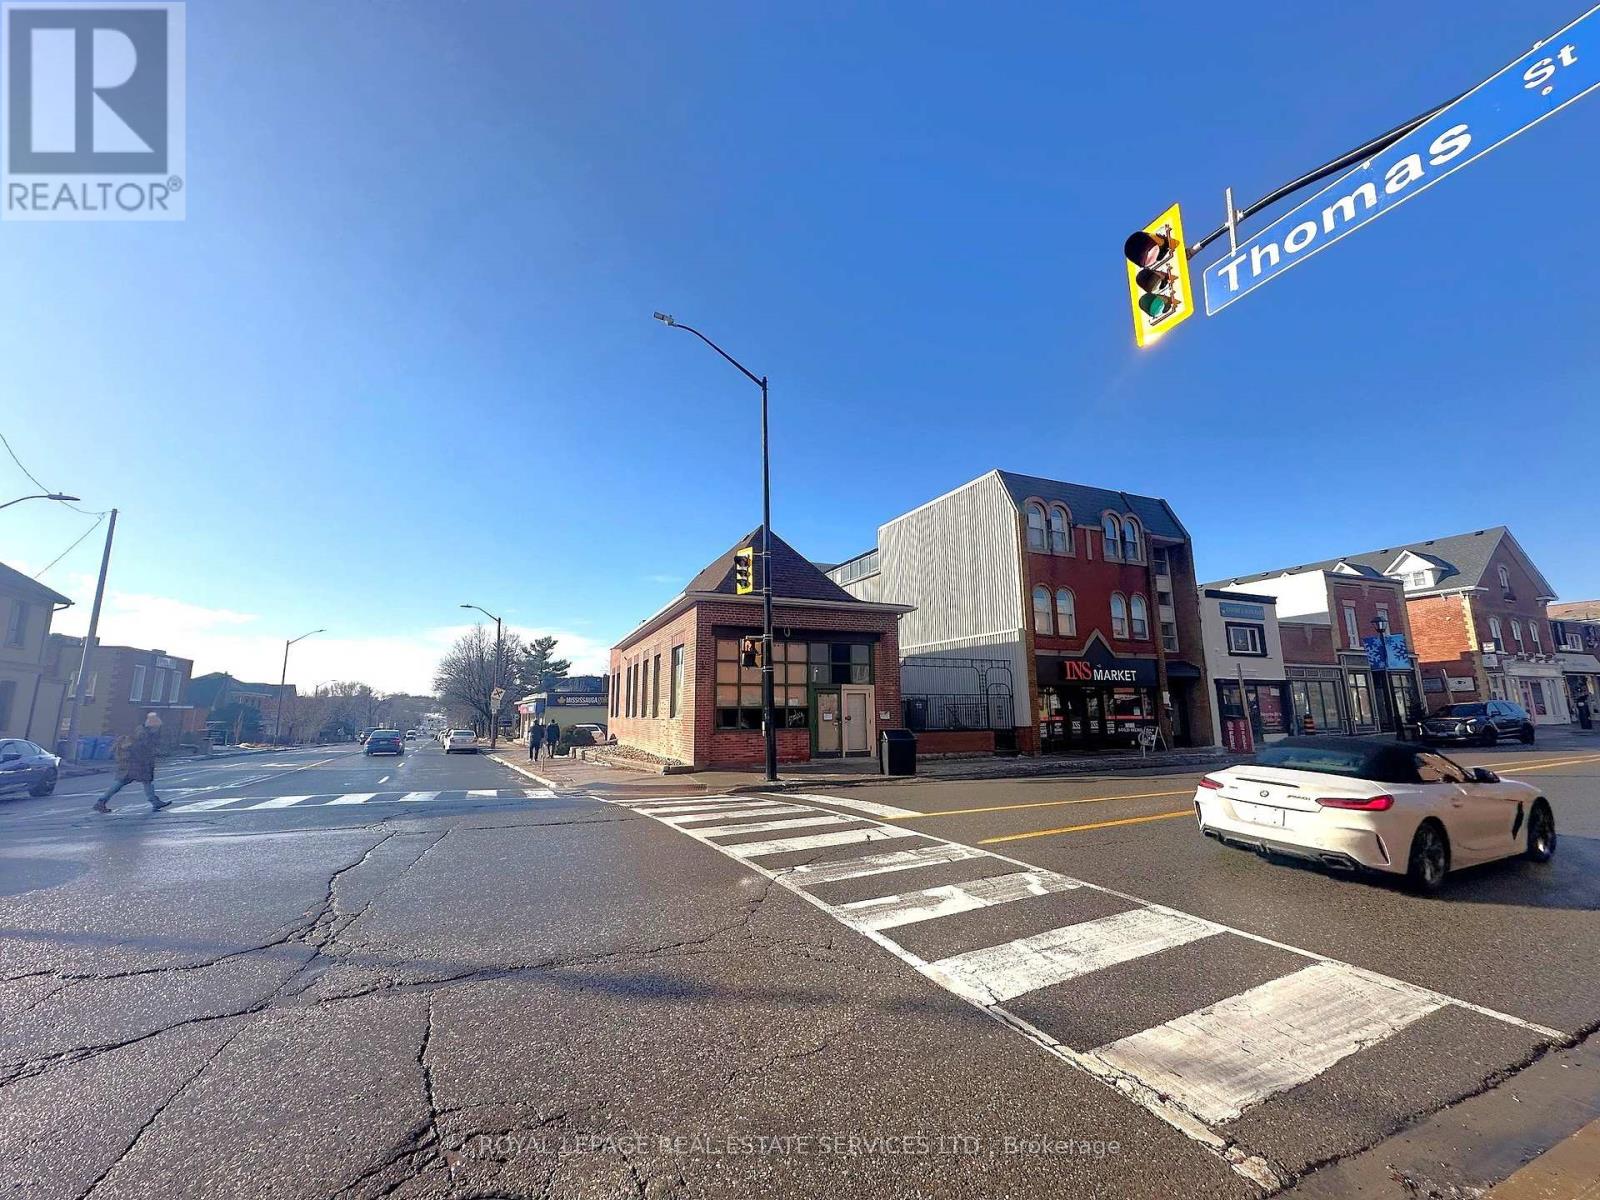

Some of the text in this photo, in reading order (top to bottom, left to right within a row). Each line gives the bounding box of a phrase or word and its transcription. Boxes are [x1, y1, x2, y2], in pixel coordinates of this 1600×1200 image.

[1217, 43, 1578, 292] Thomas St
[1064, 661, 1137, 681] INS MARKET
[566, 696, 598, 704] MISSISSAUGA
